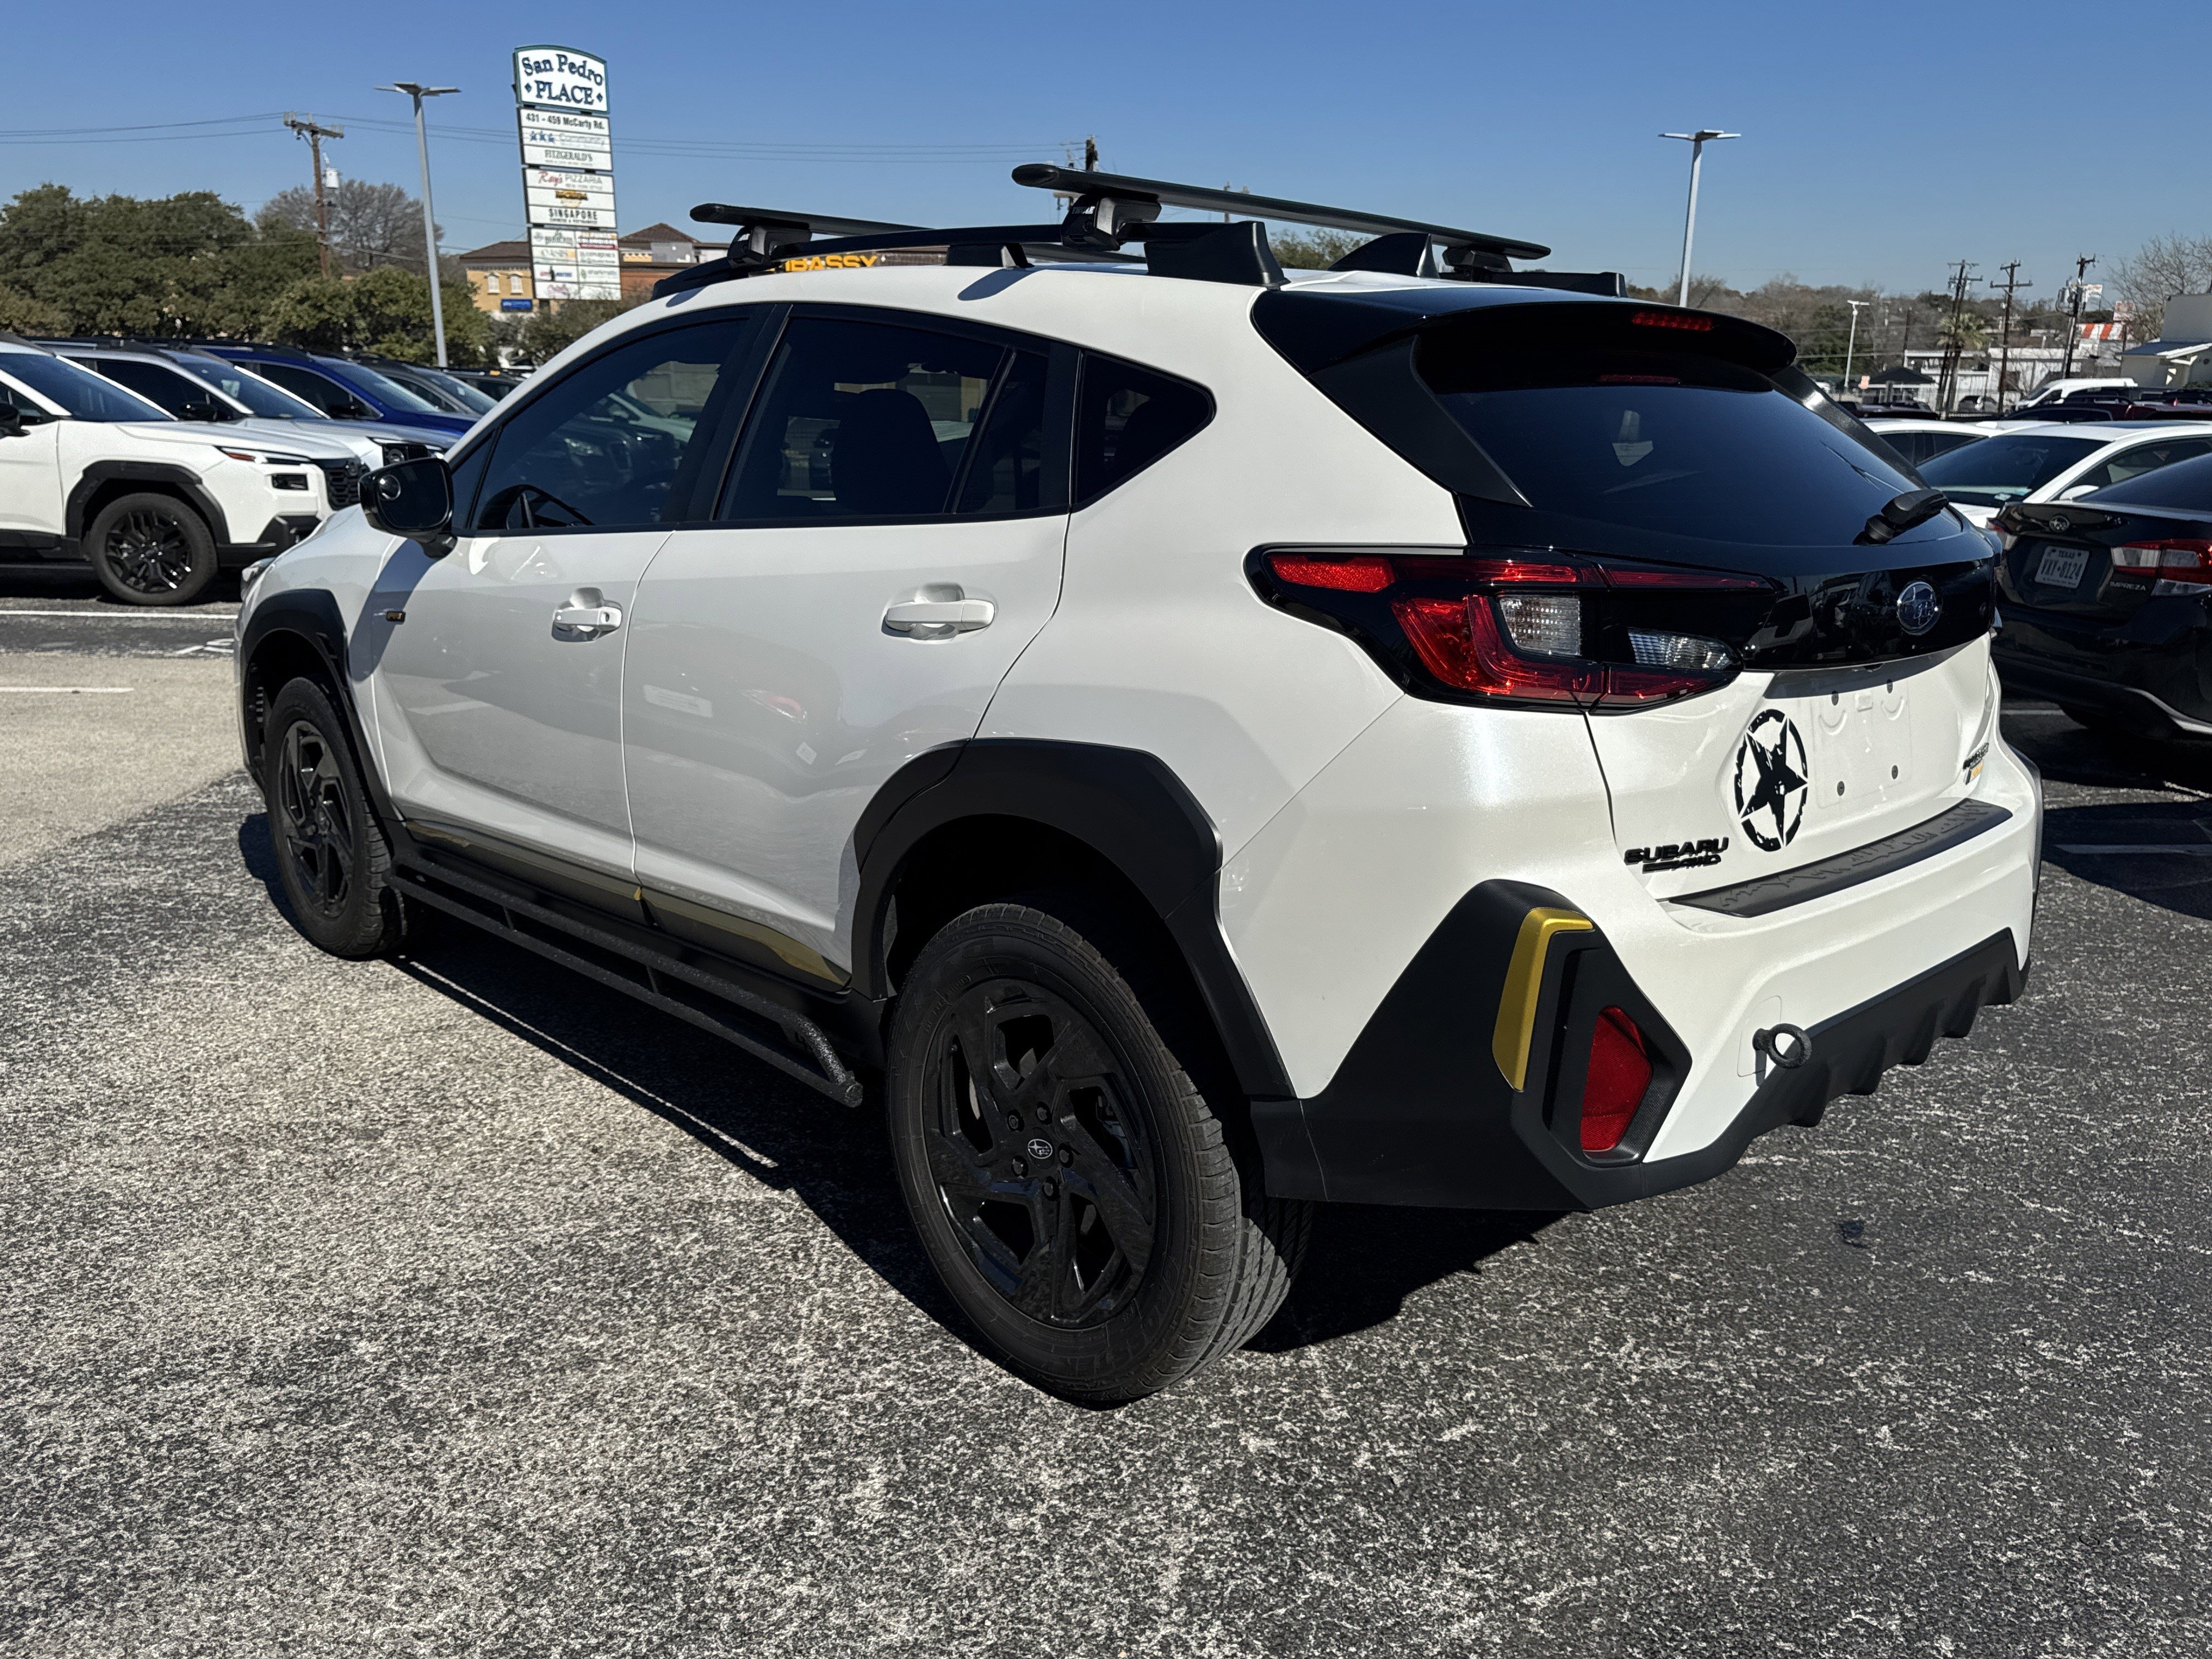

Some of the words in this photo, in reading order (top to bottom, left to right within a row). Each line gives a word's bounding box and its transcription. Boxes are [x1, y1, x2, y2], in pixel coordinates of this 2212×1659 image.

[522, 57, 554, 76] San
[556, 54, 603, 86] Pedro
[534, 80, 594, 105] PLACE
[563, 117, 591, 130] McCarty
[549, 208, 598, 219] SINGAPORE
[785, 255, 878, 272] BASSY
[1624, 837, 1729, 865] SUBARU
